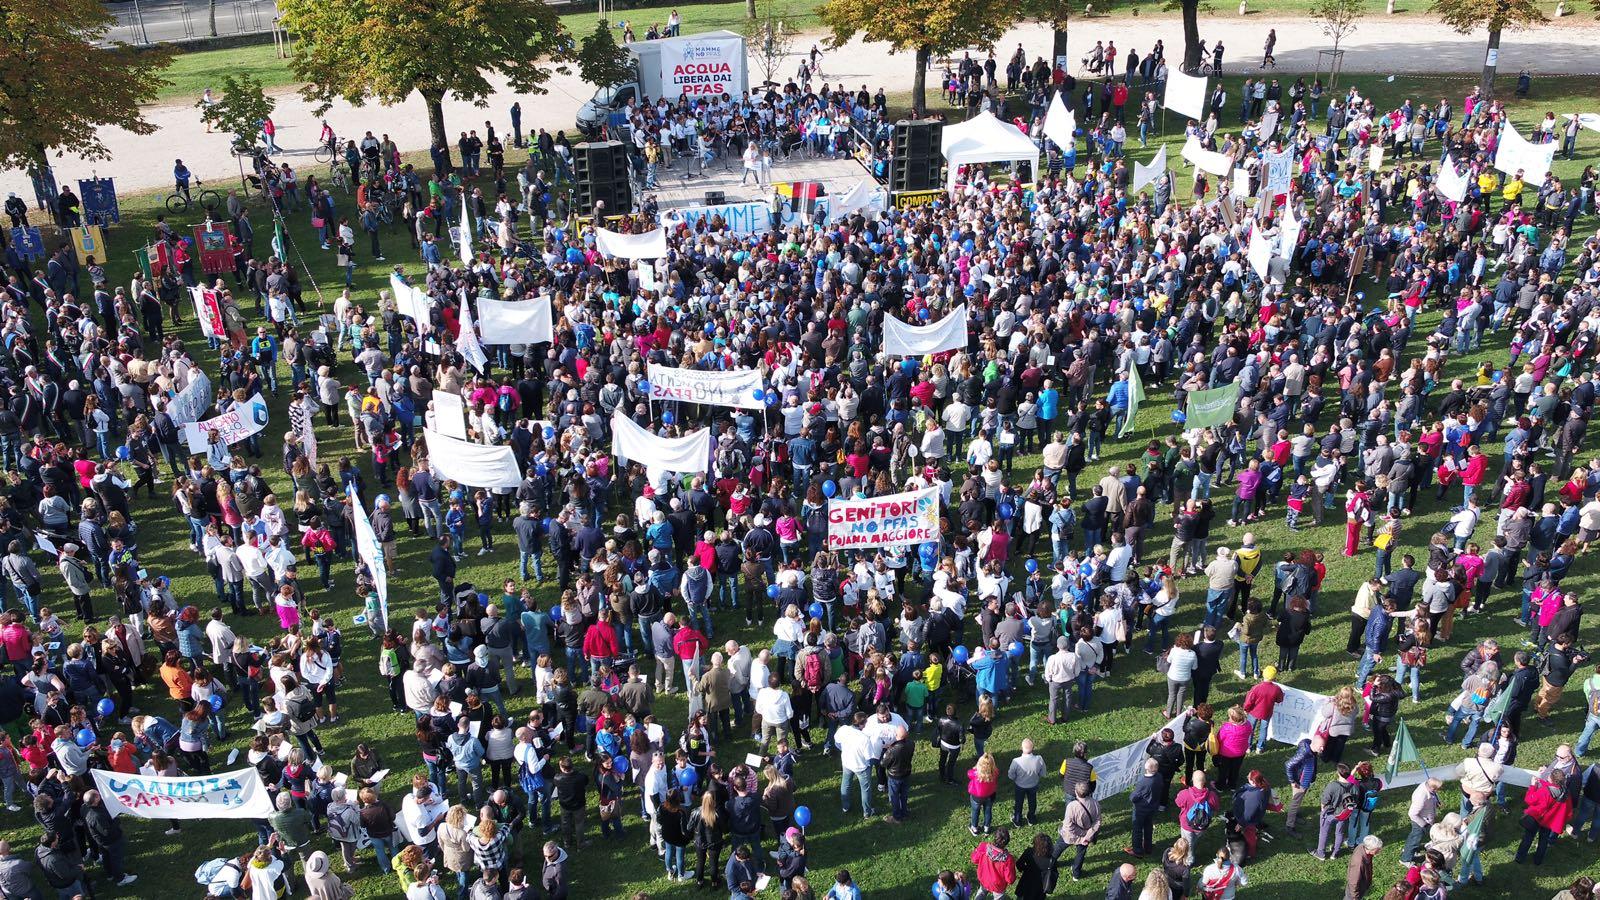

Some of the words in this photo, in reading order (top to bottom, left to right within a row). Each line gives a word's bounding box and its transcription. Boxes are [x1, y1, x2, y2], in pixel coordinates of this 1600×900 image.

[674, 63, 731, 75] ACQUA
[674, 75, 710, 84] LIBERA
[713, 74, 732, 82] DAI
[683, 83, 724, 95] PFAS
[224, 428, 249, 444] FAS
[851, 521, 878, 533] NO
[884, 516, 918, 530] PFAS
[870, 528, 930, 543] MAGGIORE
